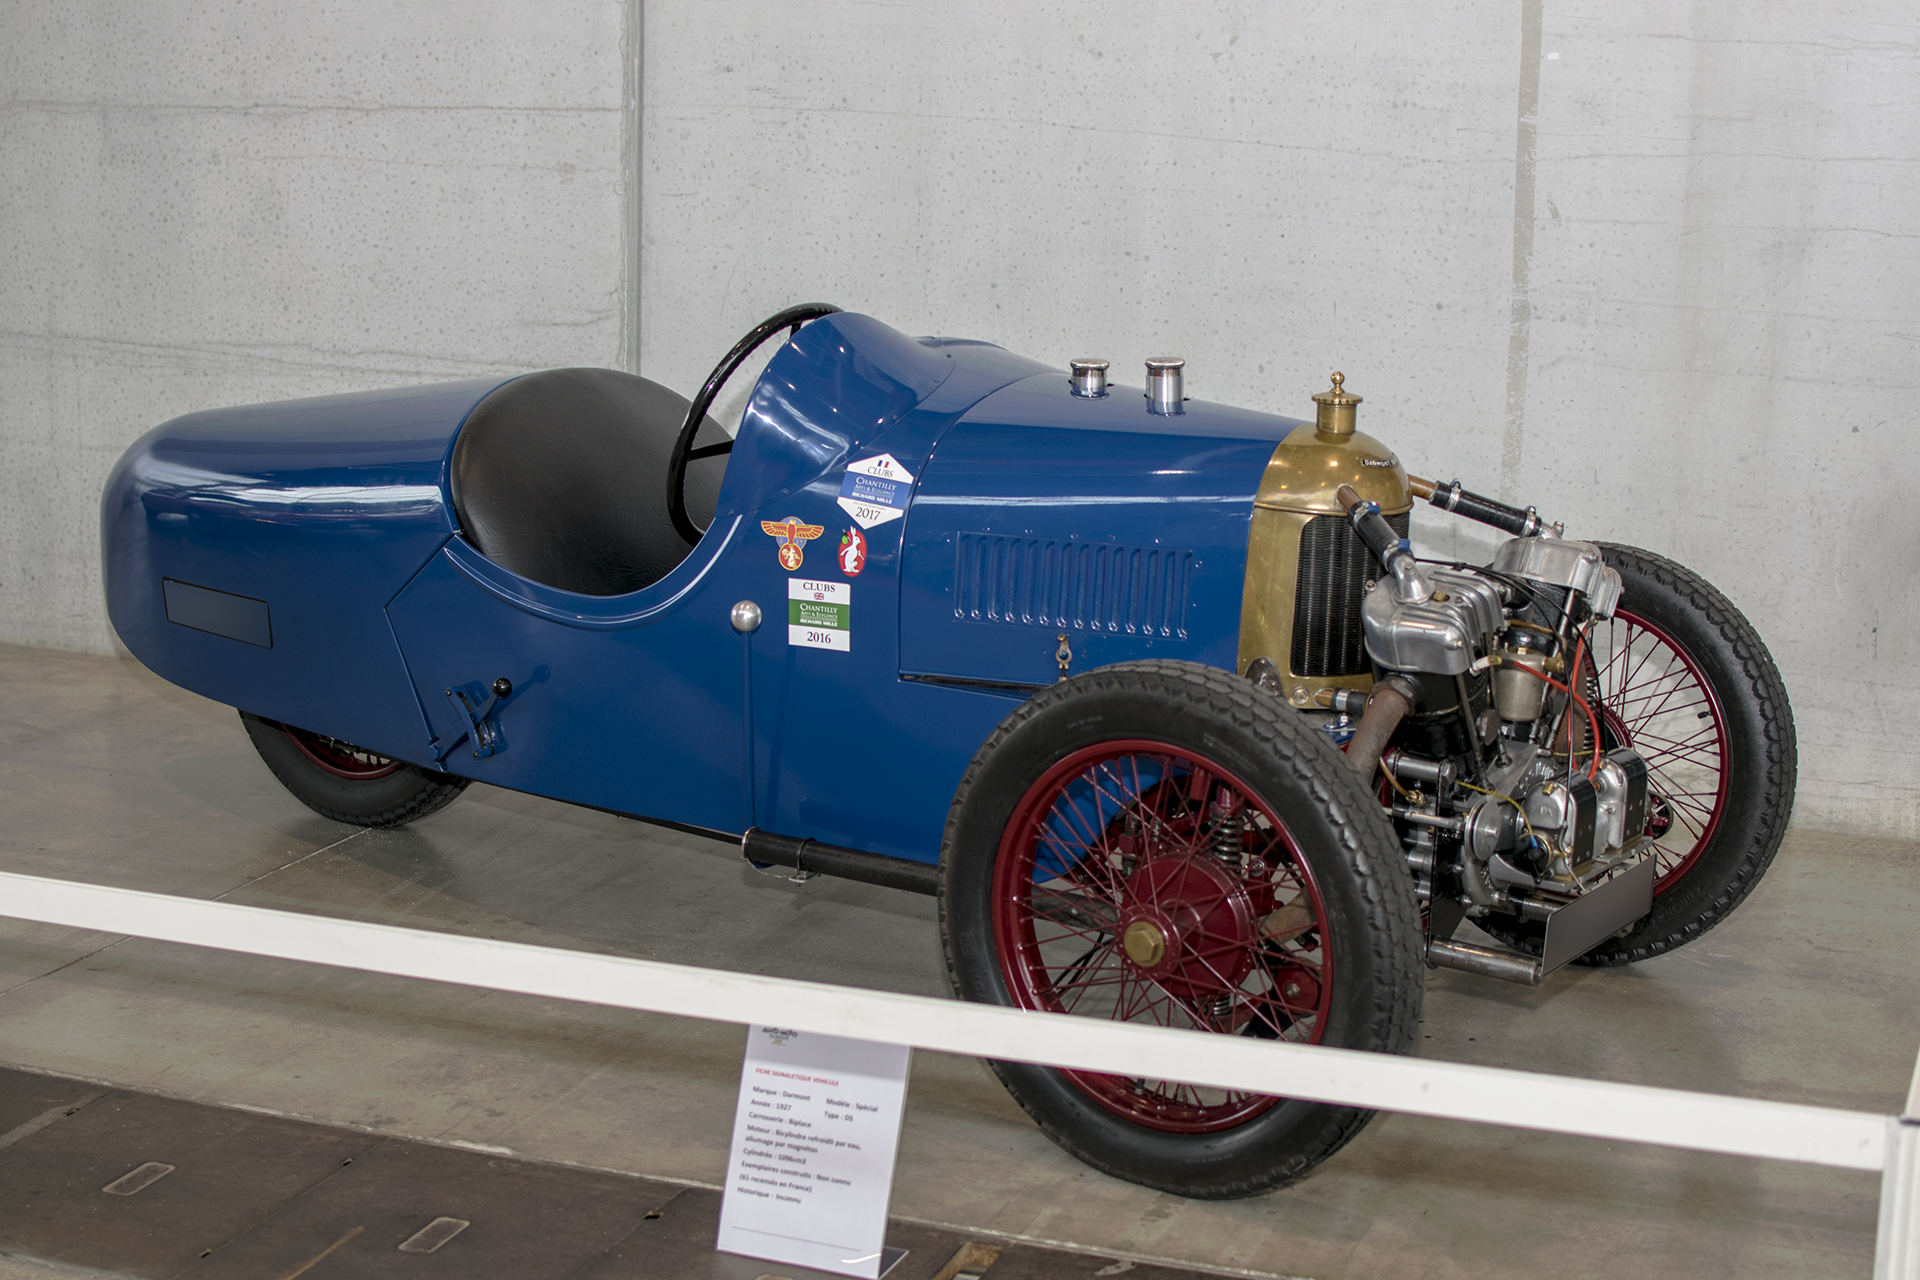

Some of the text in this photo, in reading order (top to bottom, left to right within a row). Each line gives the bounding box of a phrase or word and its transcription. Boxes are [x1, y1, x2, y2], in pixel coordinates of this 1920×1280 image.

[867, 466, 894, 478] CLUBS
[856, 476, 896, 491] CHANTILLY
[852, 492, 875, 500] RICHARD
[856, 506, 881, 520] 2017
[803, 582, 836, 593] CLUBS
[800, 603, 838, 614] CHANTILLY
[807, 631, 831, 644] 2016
[755, 1067, 839, 1086] FICHE SIGNALETIQUE VEHICULE
[753, 1086, 777, 1096] Marque
[782, 1091, 811, 1101] Darmont
[751, 1099, 770, 1107] Année
[776, 1103, 792, 1111] 1927
[826, 1098, 850, 1108] Modèle
[855, 1103, 878, 1112] Spécial
[749, 1111, 783, 1123] Carrosserie
[789, 1118, 812, 1128] Biplace
[824, 1111, 839, 1120] Type
[747, 1124, 770, 1134] Moteur
[776, 1129, 806, 1141] Bicylindre
[808, 1134, 834, 1144] refroidit
[835, 1140, 846, 1148] par
[745, 1135, 773, 1146] allumage
[787, 1142, 818, 1153] magnétos
[743, 1148, 772, 1159] Cylindrée
[778, 1154, 806, 1164] 1096cm3
[741, 1160, 779, 1173] Exemplaires
[780, 1168, 811, 1179] construits
[831, 1177, 851, 1186] connu
[751, 1175, 778, 1186] recensés
[788, 1182, 812, 1193] France)
[737, 1186, 769, 1198] Historique
